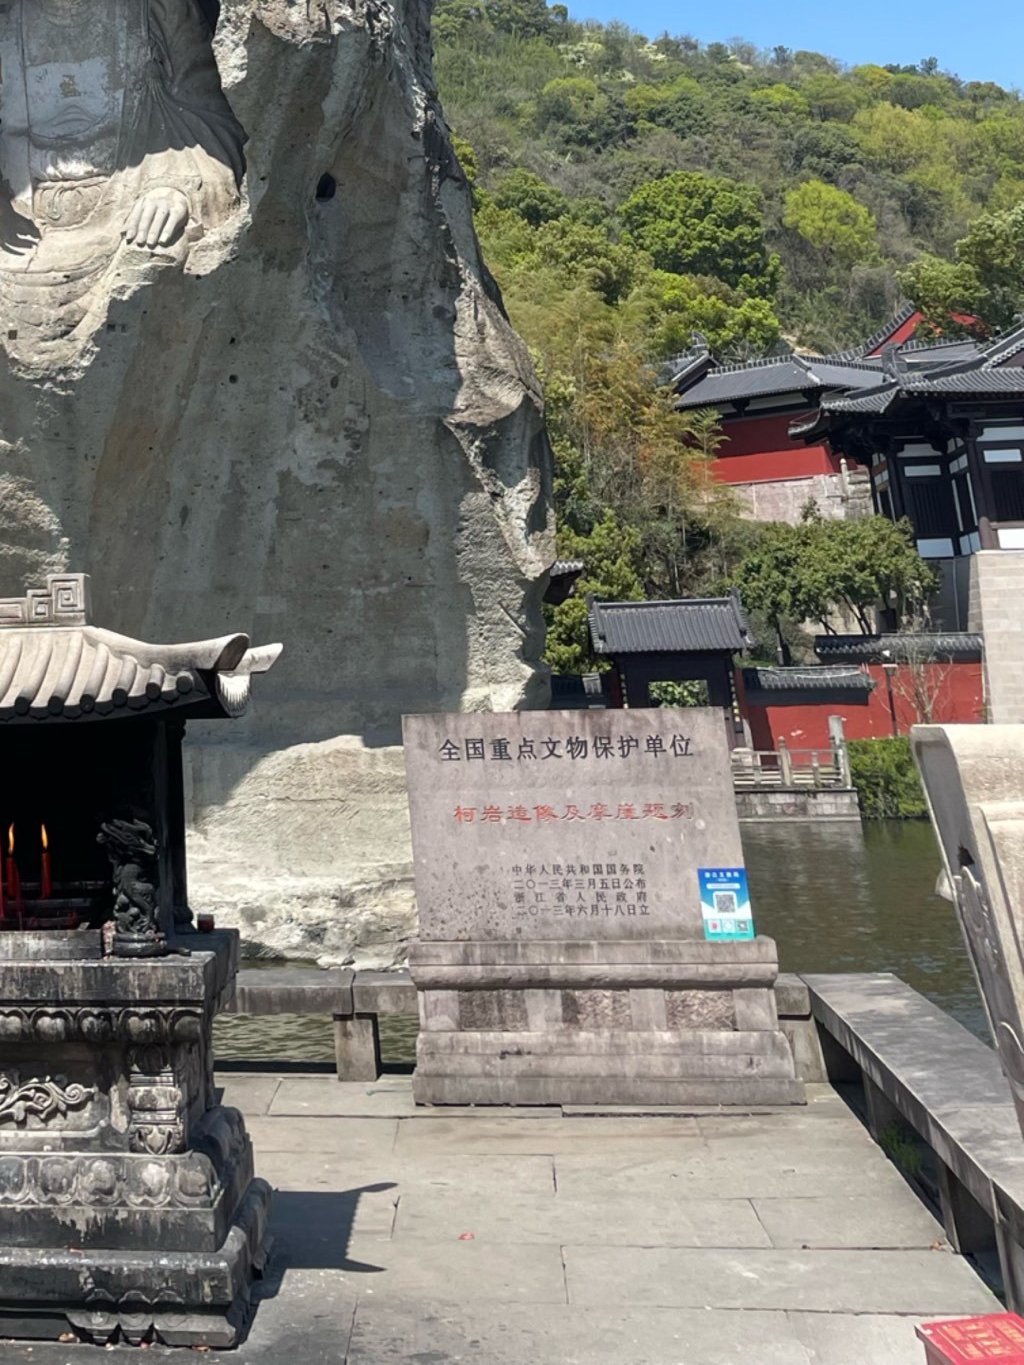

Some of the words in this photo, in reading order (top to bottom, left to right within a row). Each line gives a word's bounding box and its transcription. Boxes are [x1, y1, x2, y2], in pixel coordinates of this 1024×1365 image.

[439, 734, 694, 761] 全国重点文物保护单位
[512, 863, 645, 876] 中华人民共和国国务院
